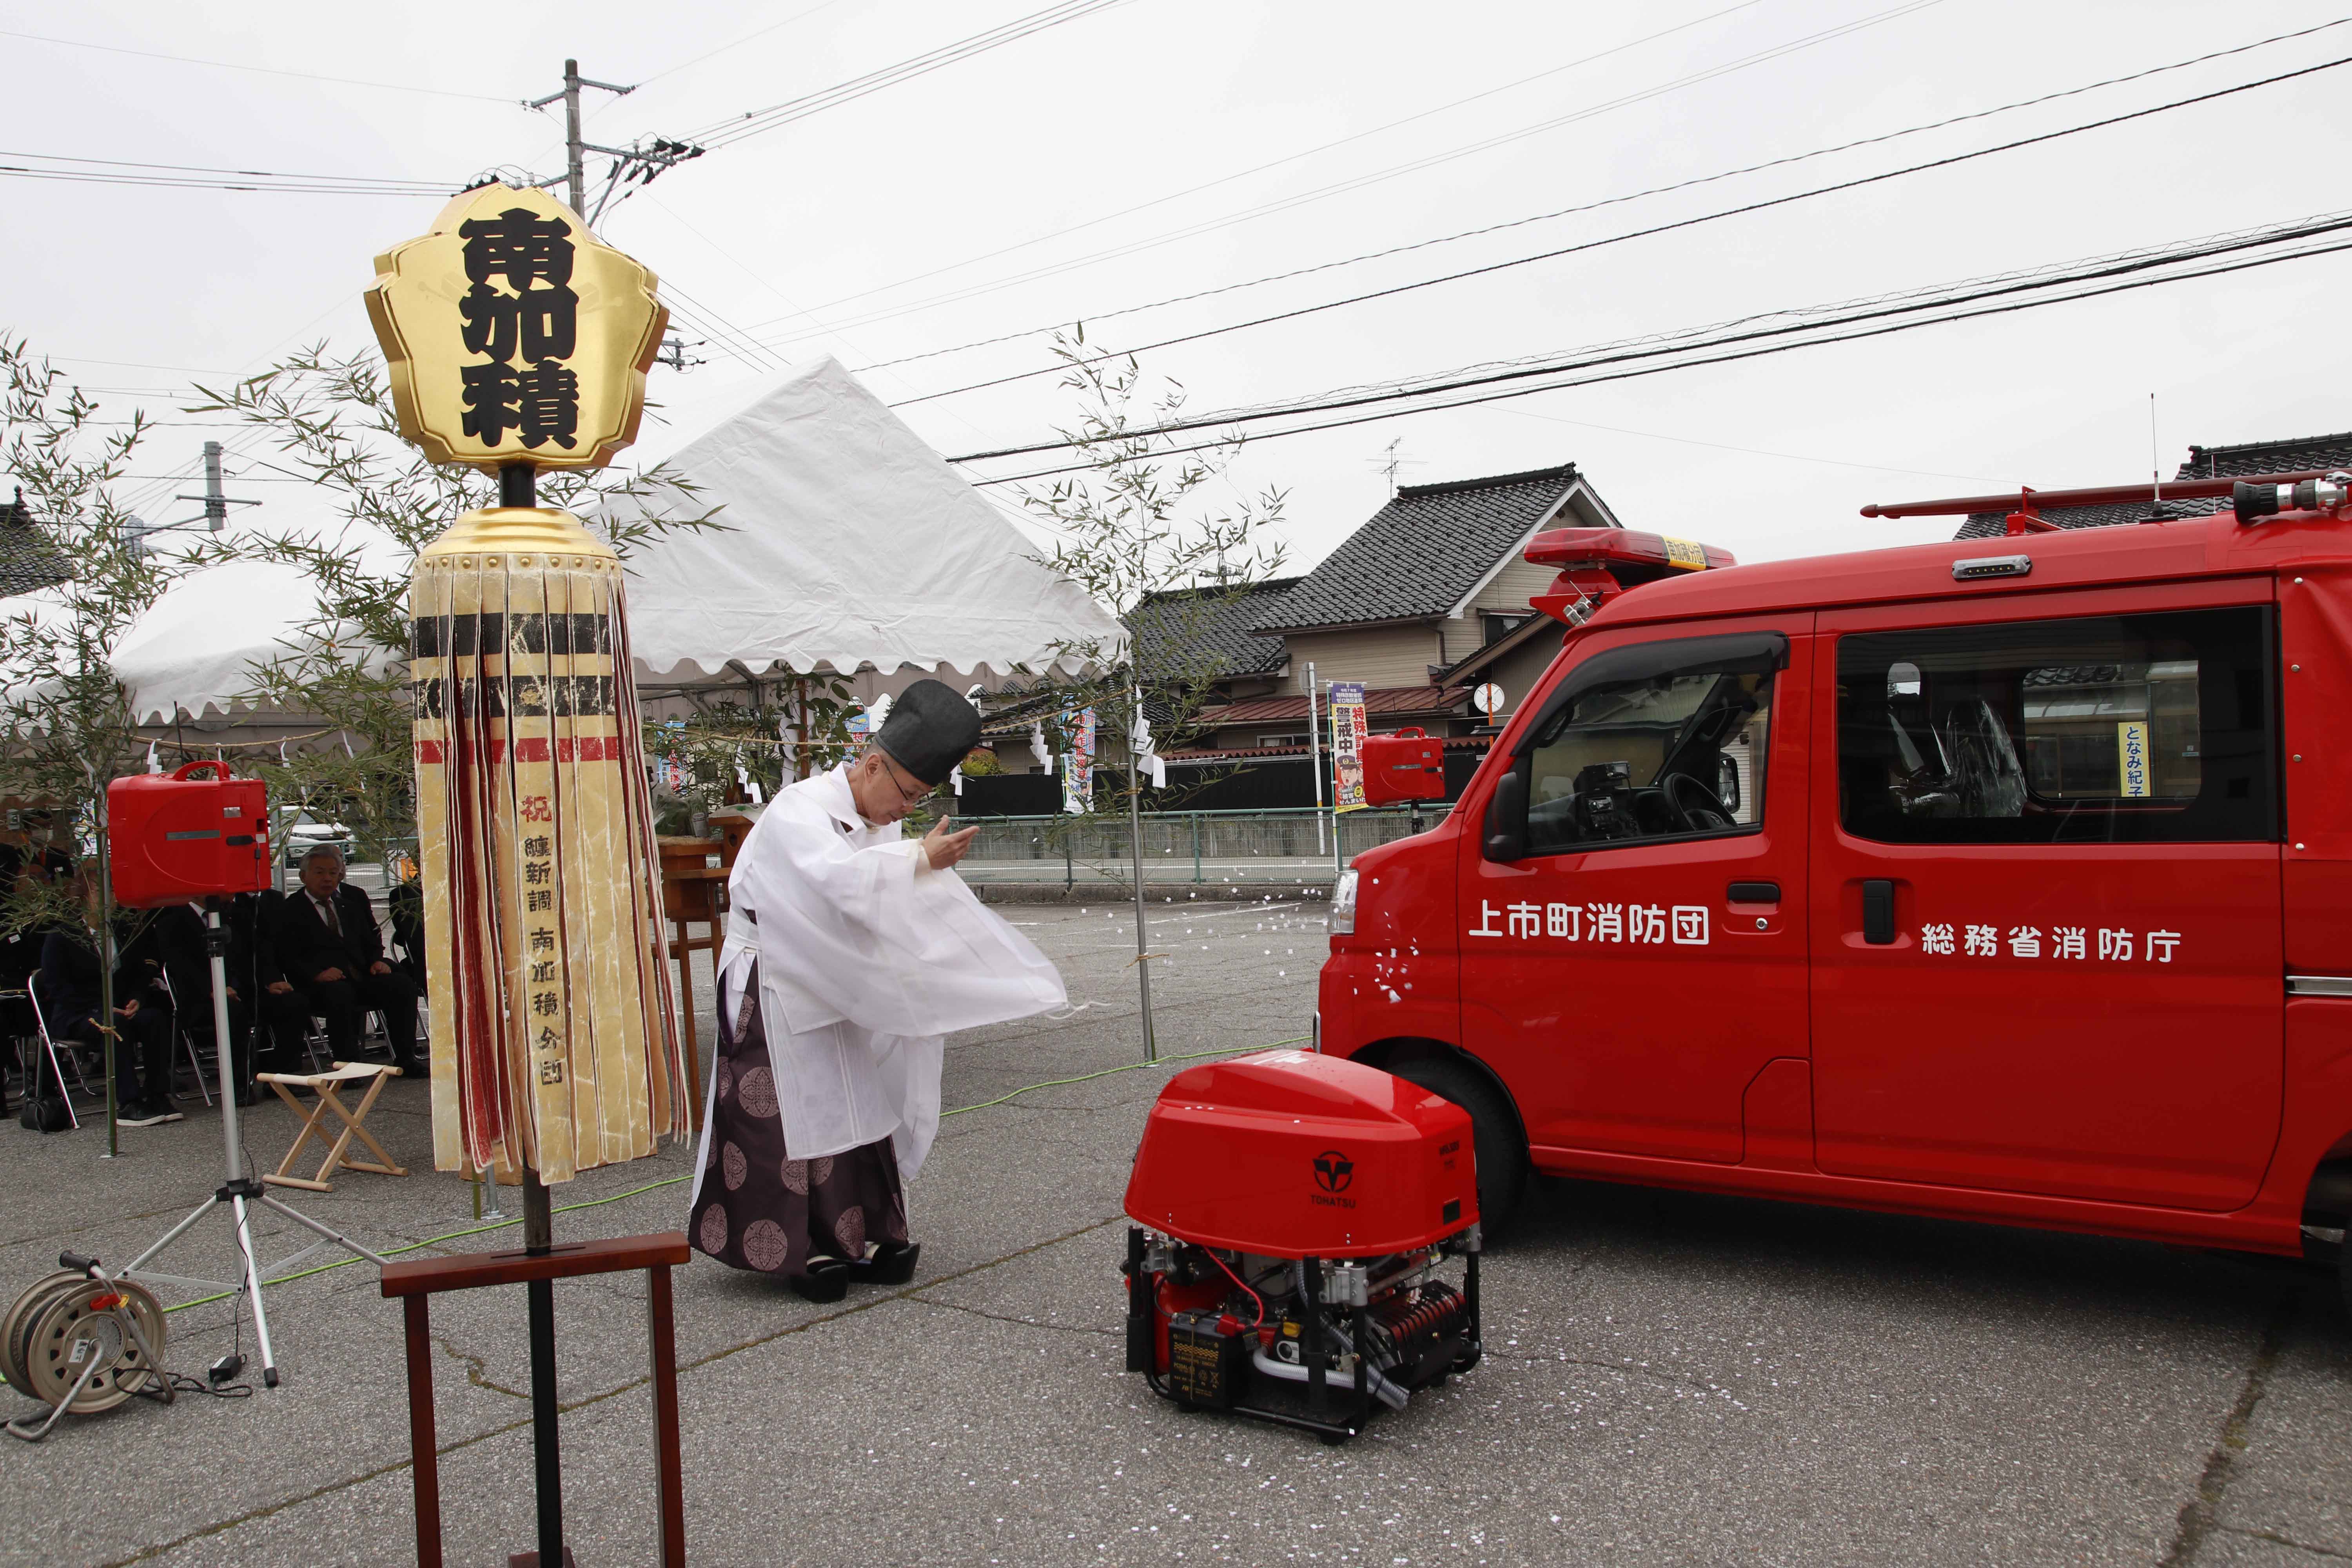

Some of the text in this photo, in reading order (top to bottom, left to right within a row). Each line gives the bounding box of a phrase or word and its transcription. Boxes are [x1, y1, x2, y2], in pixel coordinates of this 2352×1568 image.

[459, 208, 579, 449] 南加積
[1336, 707, 1353, 753] 警戒中
[2126, 726, 2143, 797] となみ紀子
[520, 795, 552, 823] 祝
[1469, 899, 1709, 945] 上市町消防団
[1922, 923, 2181, 963] 総務省消防庁
[1310, 1194, 1356, 1209] TOHATSU
